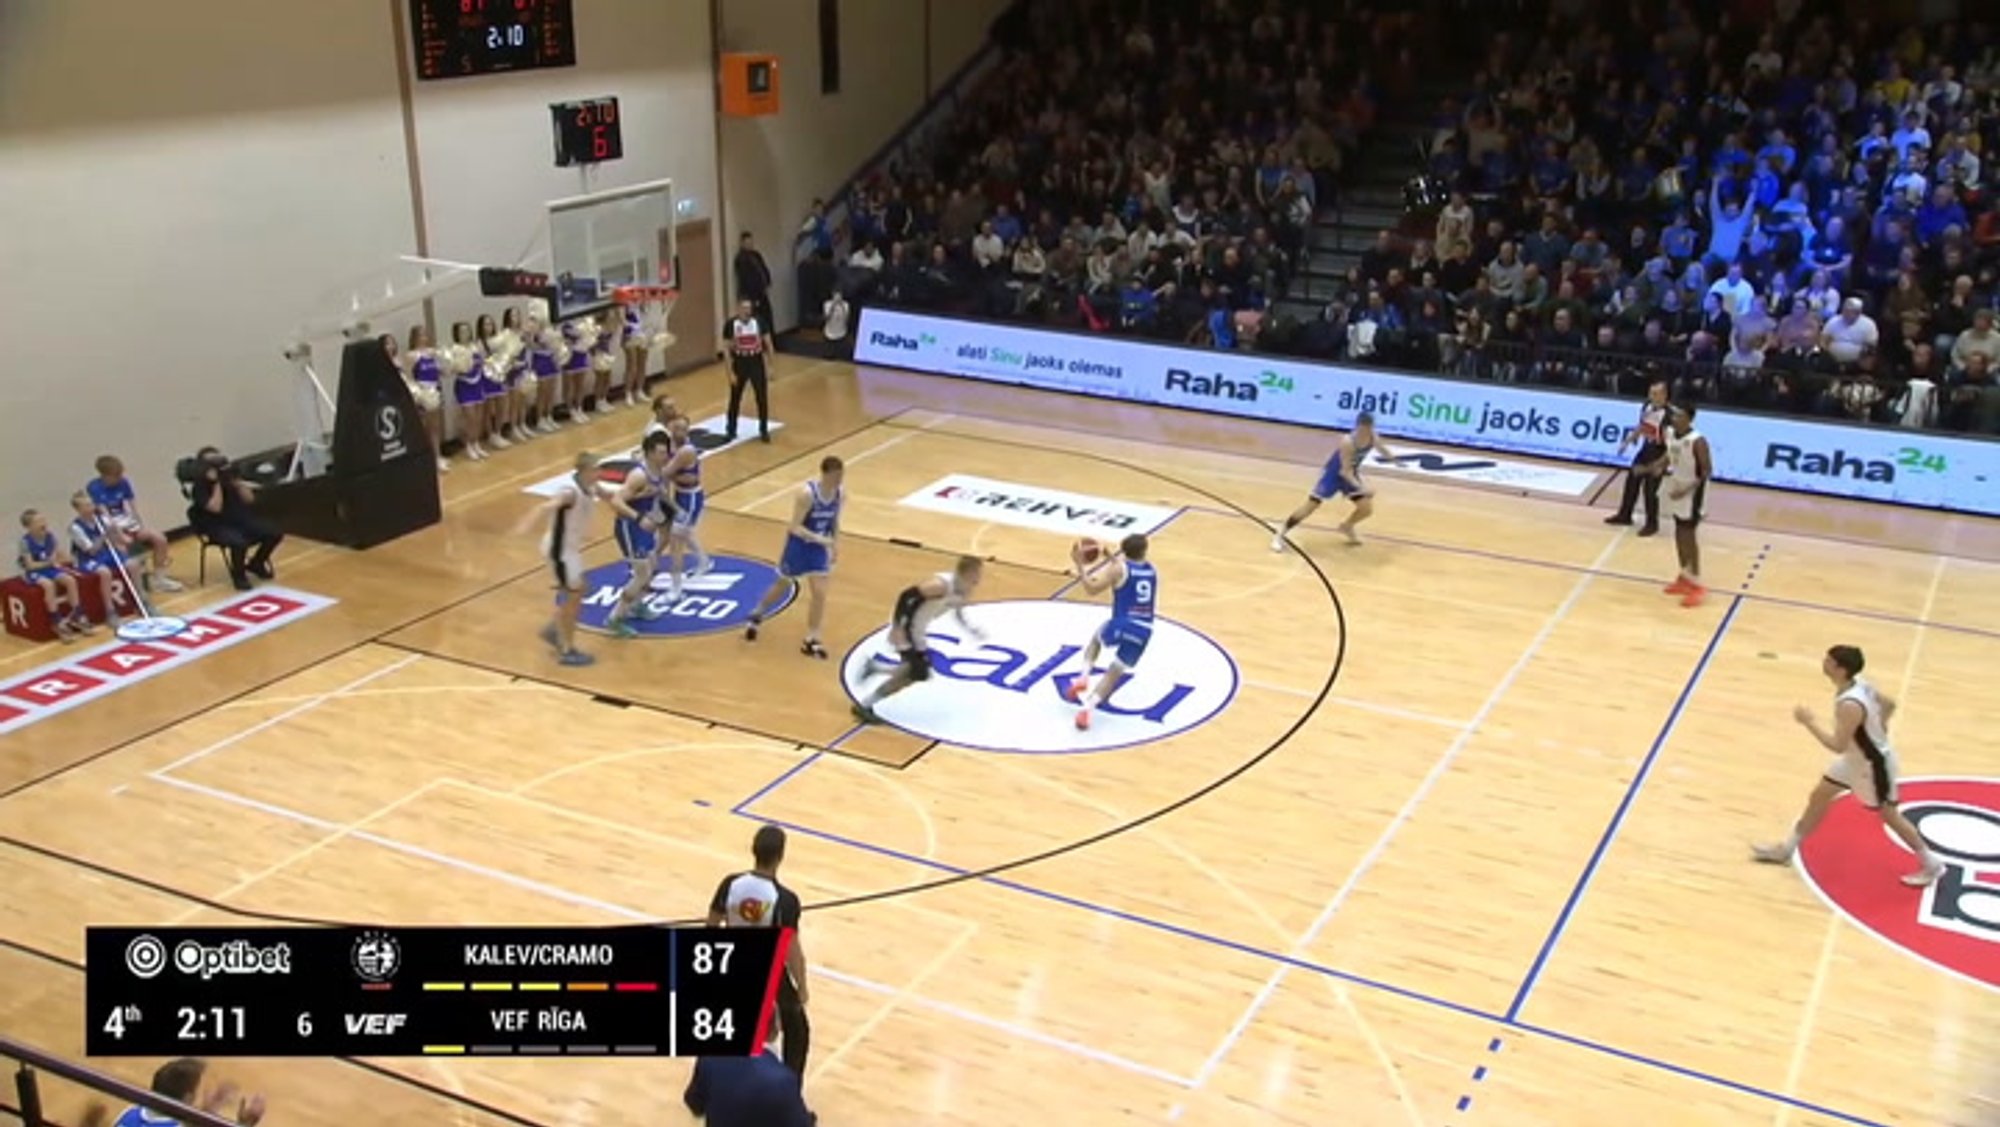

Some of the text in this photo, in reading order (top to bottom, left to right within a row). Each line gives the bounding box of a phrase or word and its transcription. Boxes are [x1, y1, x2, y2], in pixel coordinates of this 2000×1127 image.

[593, 125, 608, 158] 6
[957, 343, 987, 360] alati
[990, 346, 1024, 366] Sinu
[1024, 351, 1065, 372] jaoks
[1068, 360, 1123, 379] olemas
[1337, 386, 1399, 415] alati
[1406, 392, 1472, 425] Sinu
[1476, 402, 1561, 436] jaoks
[1135, 580, 1152, 603] 9
[8, 594, 29, 629] R
